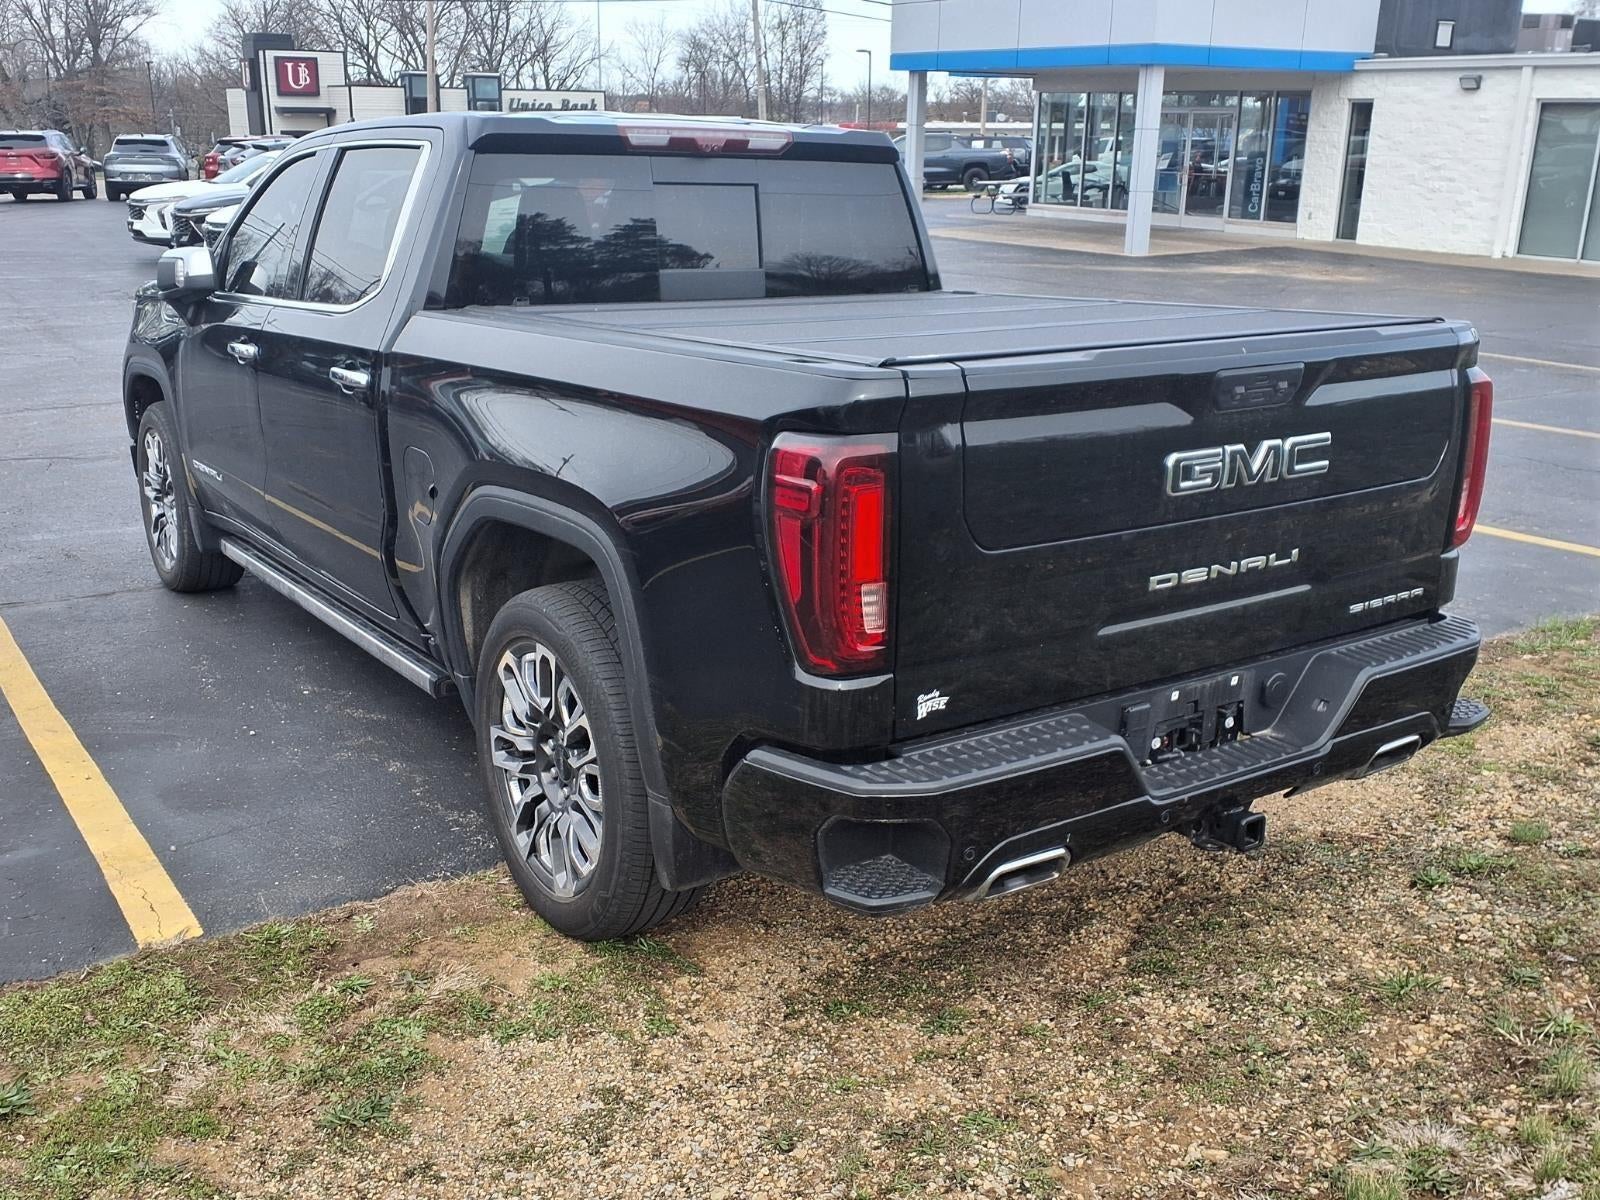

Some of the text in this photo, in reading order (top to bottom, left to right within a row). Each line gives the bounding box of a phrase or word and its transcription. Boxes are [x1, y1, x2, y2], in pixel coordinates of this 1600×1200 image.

[508, 97, 598, 112] Unico Bank
[1248, 157, 1264, 213] CarBravo
[1165, 431, 1332, 496] GMC
[1148, 548, 1299, 592] DENALI
[1349, 587, 1424, 614] SIERRA
